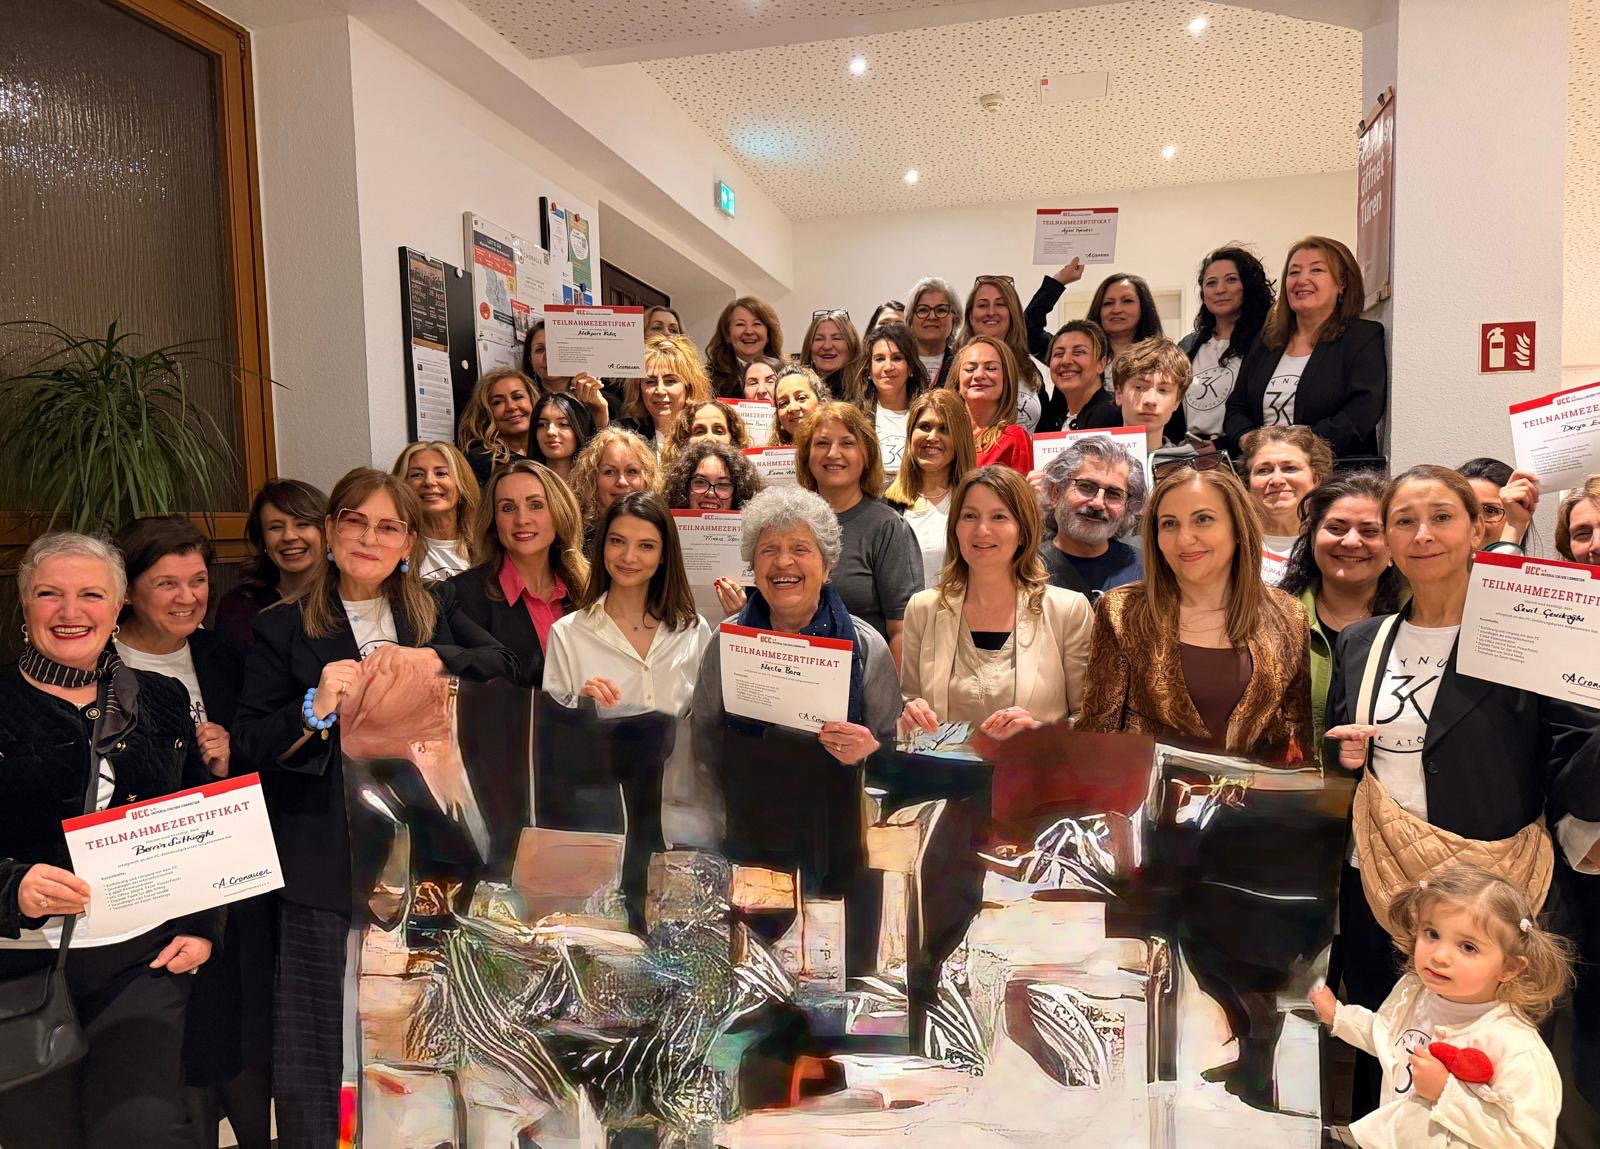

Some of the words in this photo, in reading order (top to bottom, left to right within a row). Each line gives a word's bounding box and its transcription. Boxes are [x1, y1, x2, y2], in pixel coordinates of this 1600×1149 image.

[1360, 152, 1385, 196] öffnet
[1360, 190, 1382, 228] Türen
[552, 320, 636, 328] TEILNAHMEZERTIFIKAT
[1525, 566, 1541, 576] UCC
[729, 644, 840, 668] TEILNAHMEZERTIFIKAT
[85, 801, 250, 850] TEILNAHMEZERTIFIKAT
[131, 808, 150, 820] UCC
